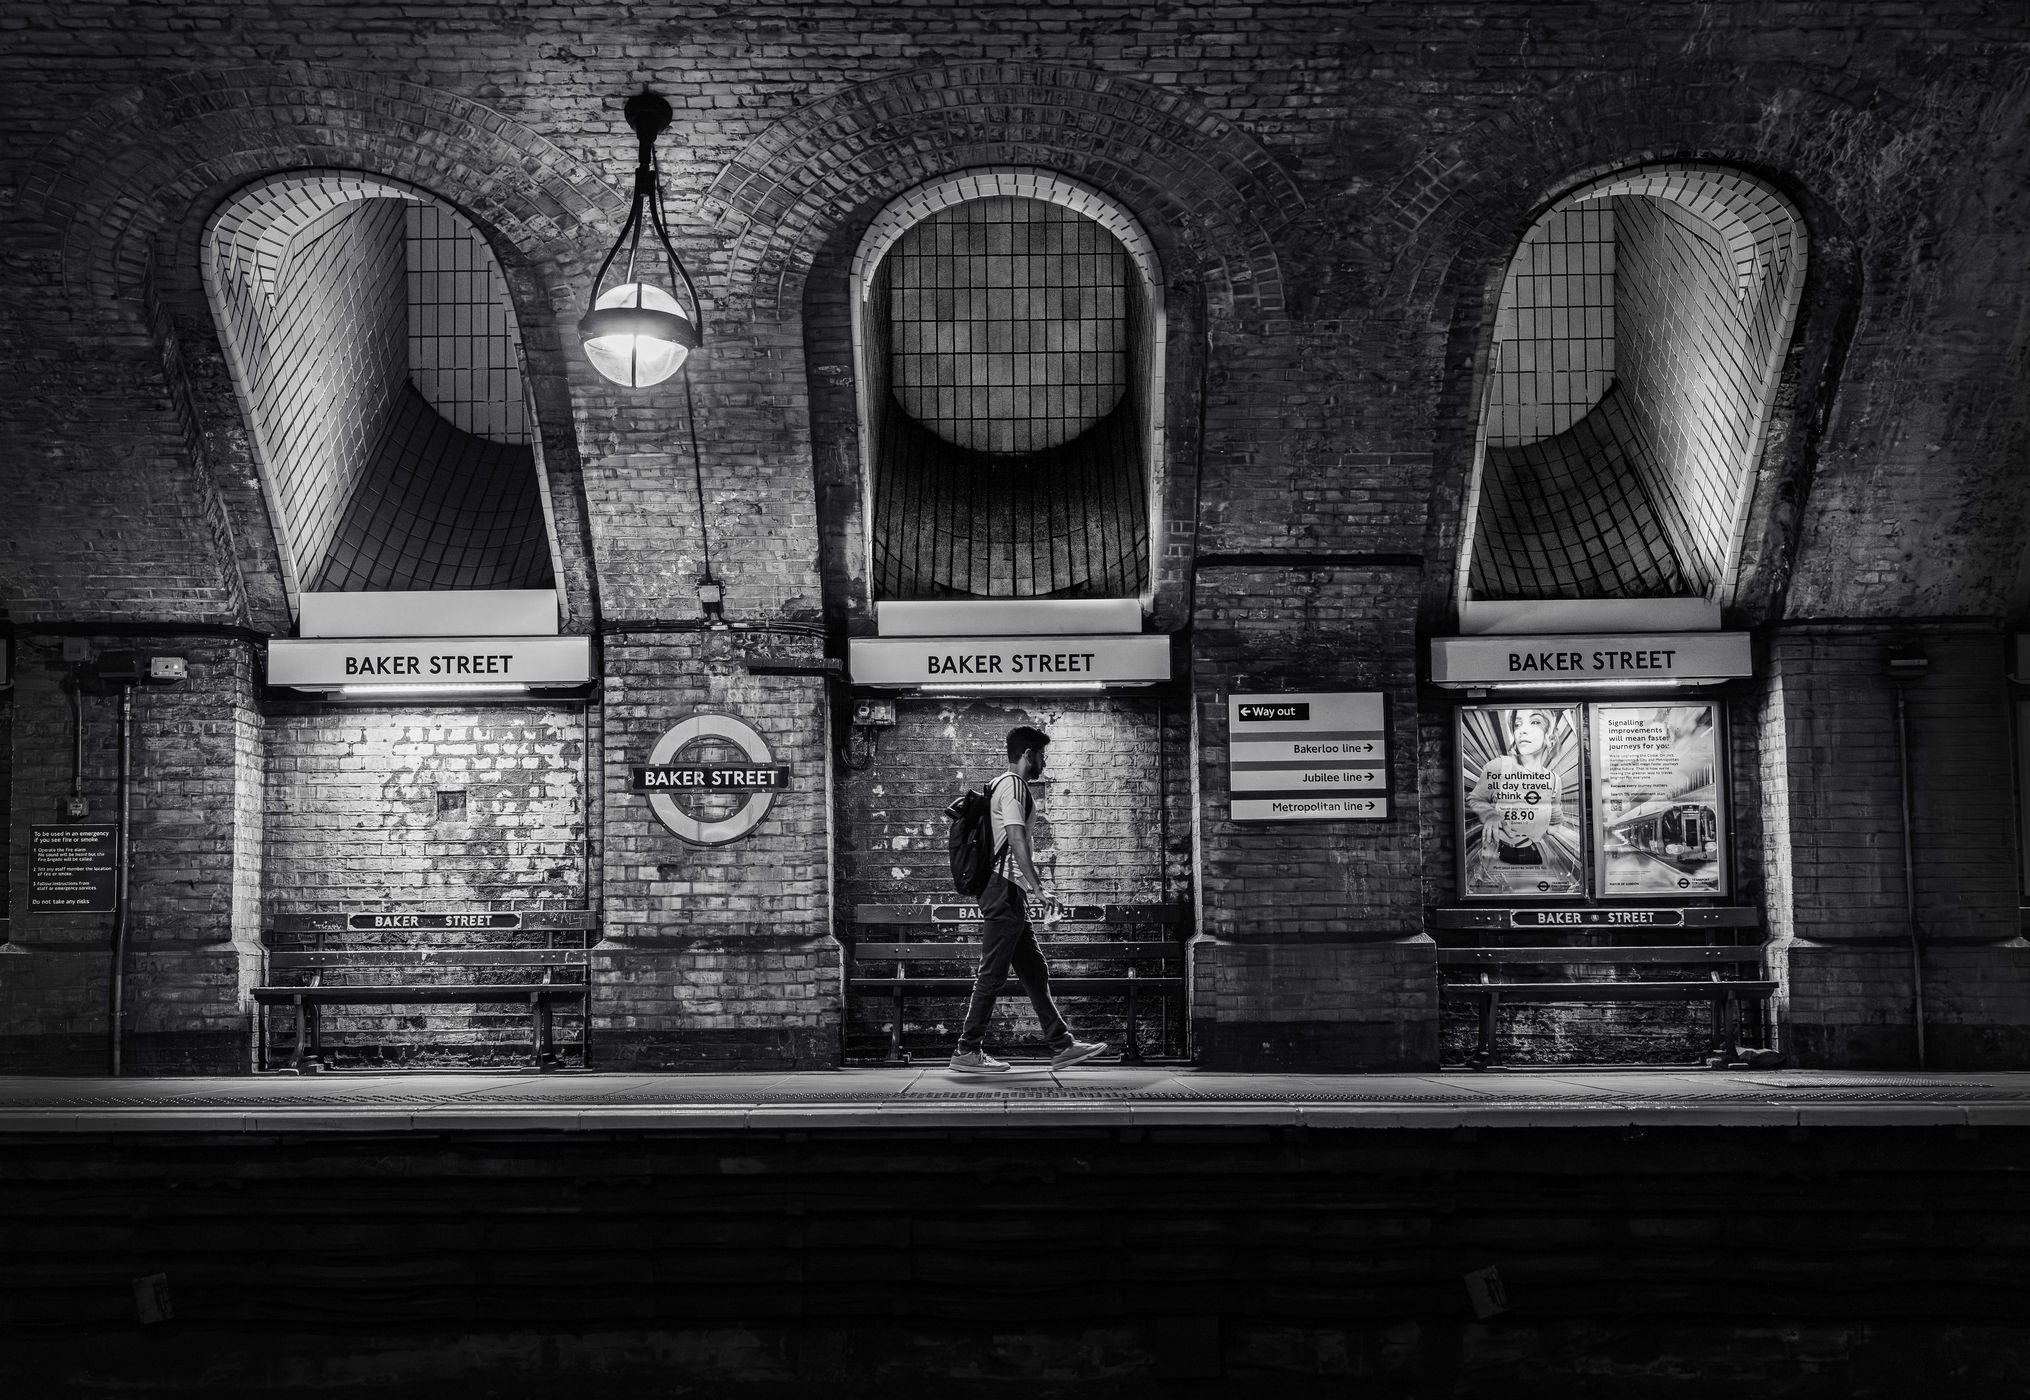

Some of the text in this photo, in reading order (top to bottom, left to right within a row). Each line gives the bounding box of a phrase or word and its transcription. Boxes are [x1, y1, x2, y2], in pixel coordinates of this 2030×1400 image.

[345, 655, 513, 675] BAKER STREET
[928, 653, 1095, 674] BAKER STREET
[1508, 650, 1676, 672] BAKER STREET
[1252, 706, 1296, 718] Way out
[1608, 719, 1644, 727] Signalling
[1608, 727, 1663, 735] improvements
[1293, 743, 1362, 754] Bakerloo line
[1608, 743, 1641, 751] journeys
[644, 770, 779, 786] BAKER STREET
[1302, 772, 1363, 783] Jubilee line
[1486, 771, 1551, 780] For unlimited
[1487, 782, 1500, 790] all
[1502, 782, 1520, 791] day
[1496, 792, 1522, 800] think
[1272, 801, 1363, 814] Metropolitan line
[1504, 810, 1535, 821] £8.90
[959, 907, 1077, 919] BAK STET
[1537, 912, 1655, 924] BAKER STREET
[374, 914, 493, 928] BAKER STREET
